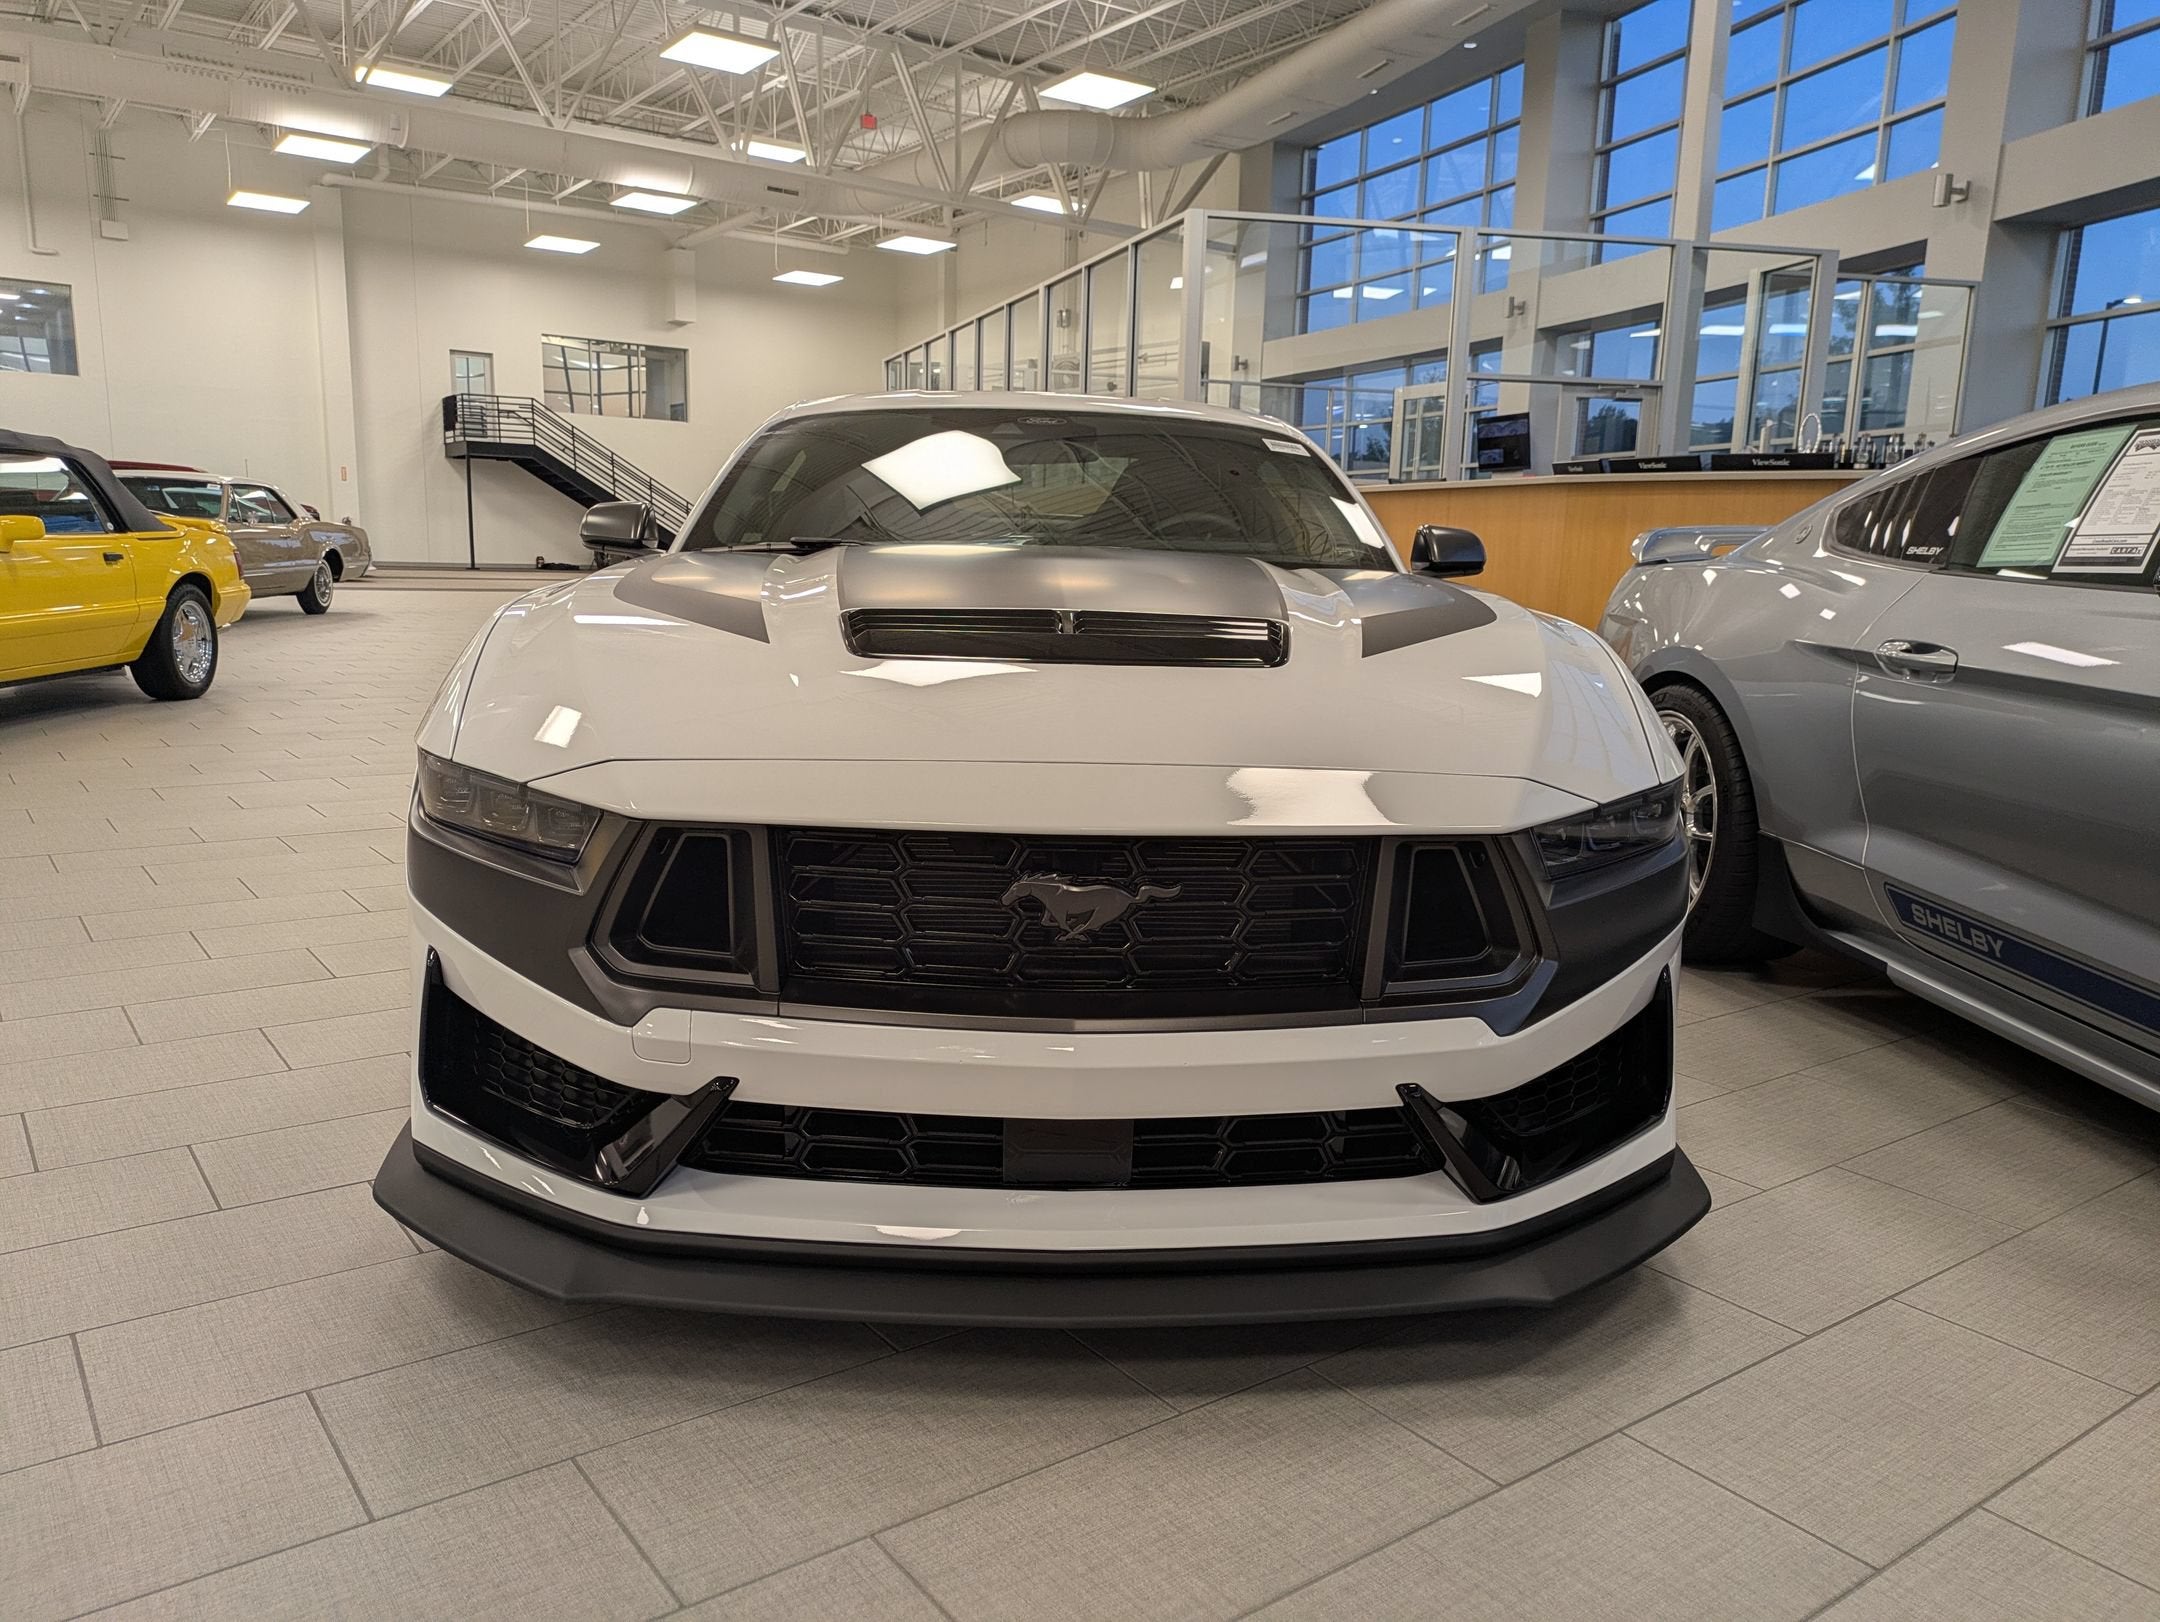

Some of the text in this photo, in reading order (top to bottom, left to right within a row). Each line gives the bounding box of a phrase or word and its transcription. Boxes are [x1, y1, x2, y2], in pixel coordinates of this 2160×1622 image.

[1752, 458, 1791, 467] ViewSonic
[1906, 546, 1944, 555] SHELBY
[1911, 903, 2004, 958] SHELBY
